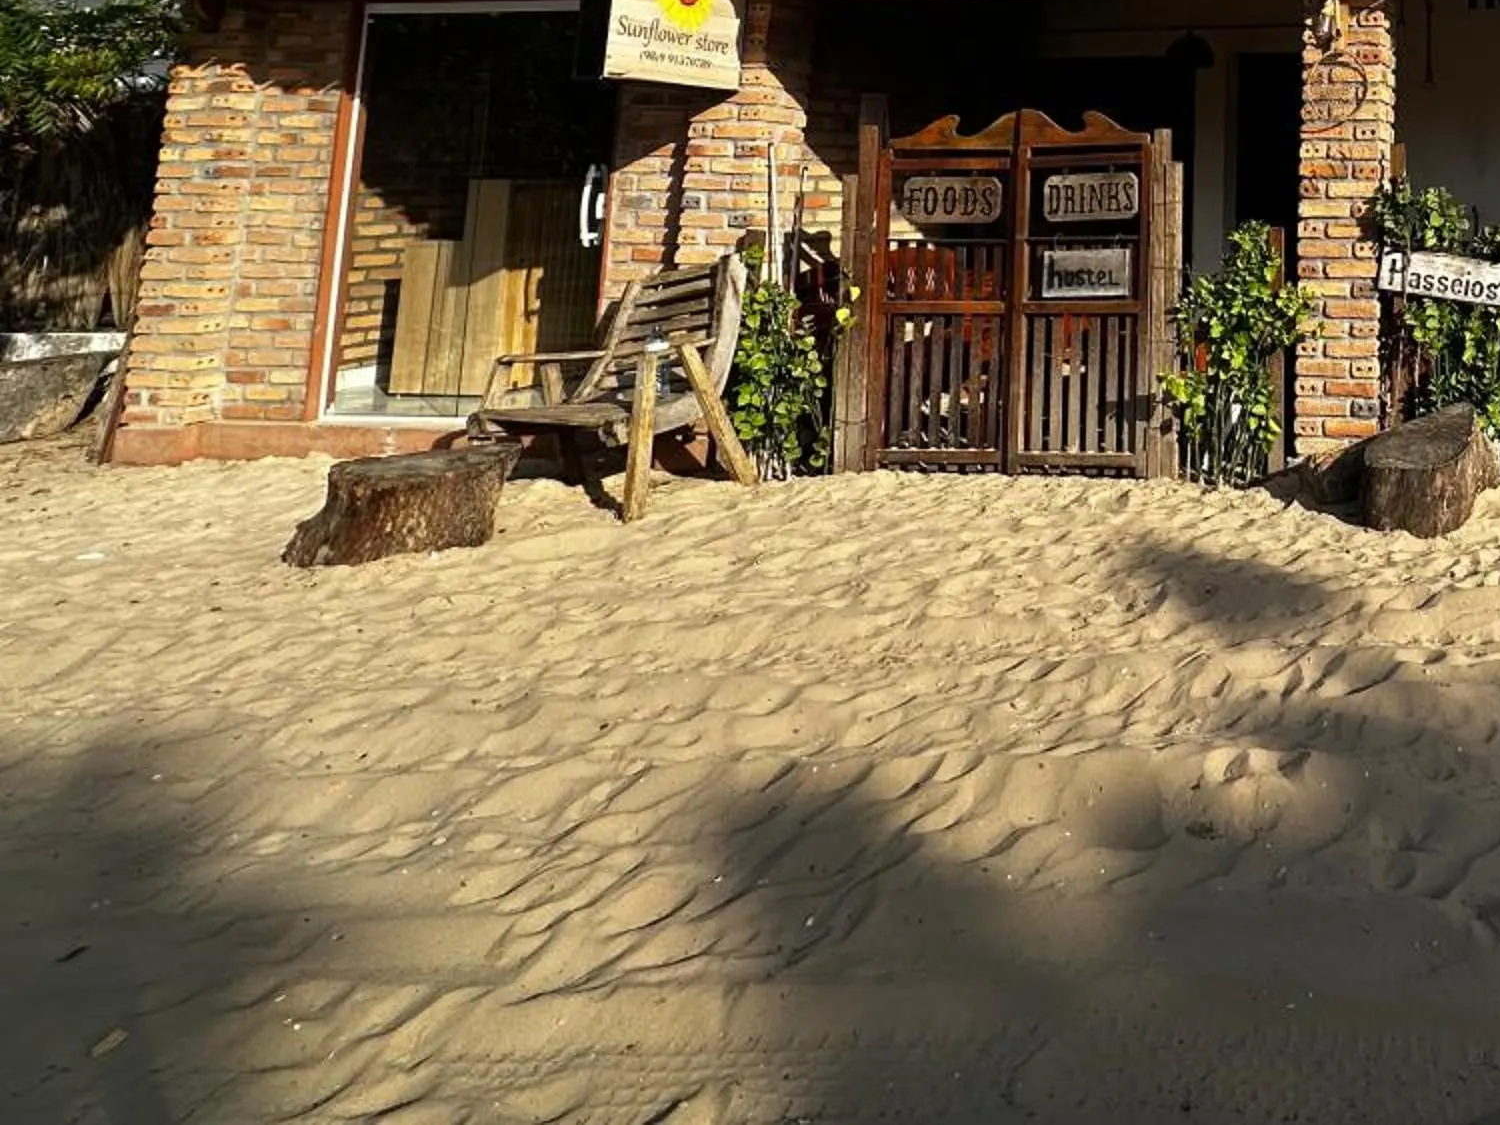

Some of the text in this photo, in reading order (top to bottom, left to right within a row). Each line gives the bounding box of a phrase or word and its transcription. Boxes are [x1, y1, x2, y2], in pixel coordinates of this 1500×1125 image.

[616, 14, 729, 55] Sunflower store
[904, 186, 993, 216] FOODS
[1047, 181, 1135, 216] DRINKS
[1384, 250, 1499, 301] Passeios
